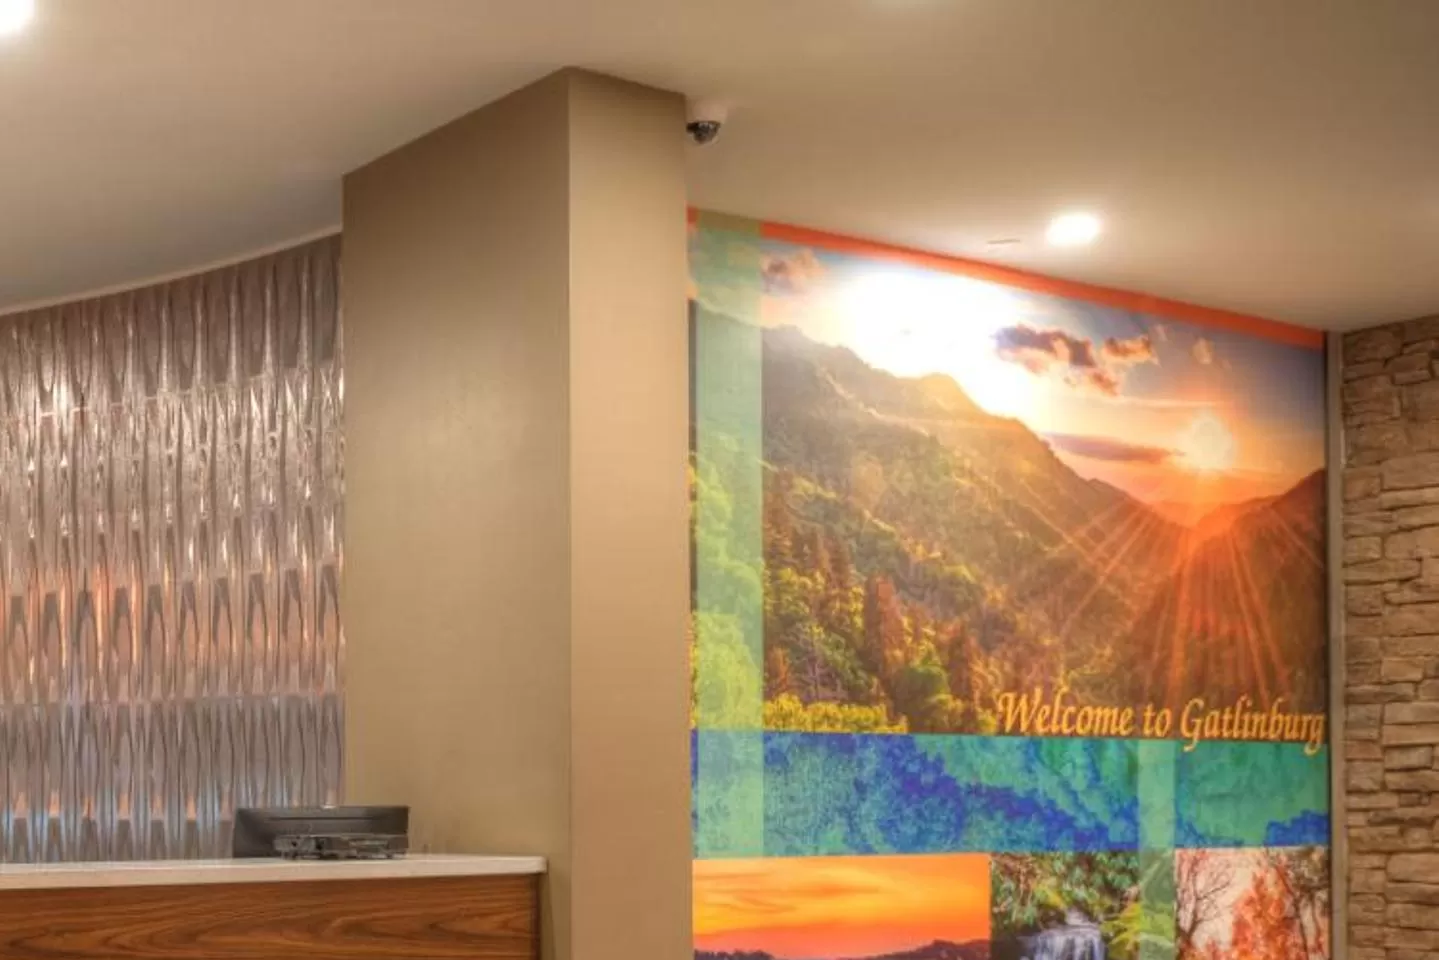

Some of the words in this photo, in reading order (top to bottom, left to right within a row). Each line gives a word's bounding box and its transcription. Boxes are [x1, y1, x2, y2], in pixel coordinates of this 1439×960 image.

[993, 686, 1133, 736] Welcome
[1142, 702, 1173, 737] to
[1179, 694, 1326, 756] Gatlinburg
